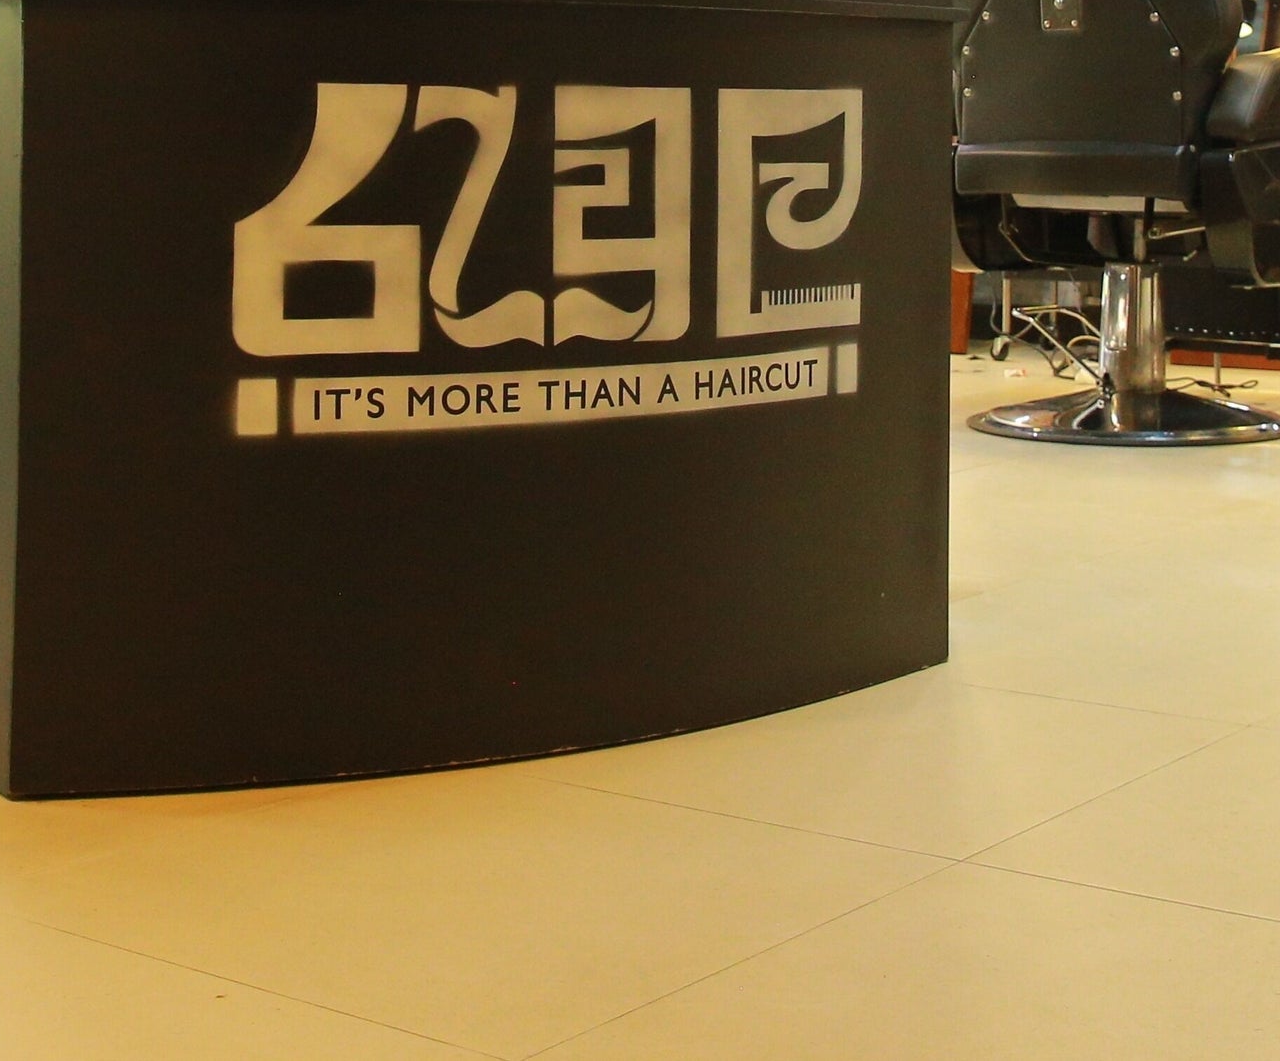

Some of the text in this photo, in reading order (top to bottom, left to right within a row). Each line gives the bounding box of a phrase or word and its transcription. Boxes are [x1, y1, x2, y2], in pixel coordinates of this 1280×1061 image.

[313, 359, 818, 421] IT'S MORE THAN A HAIRCUT
